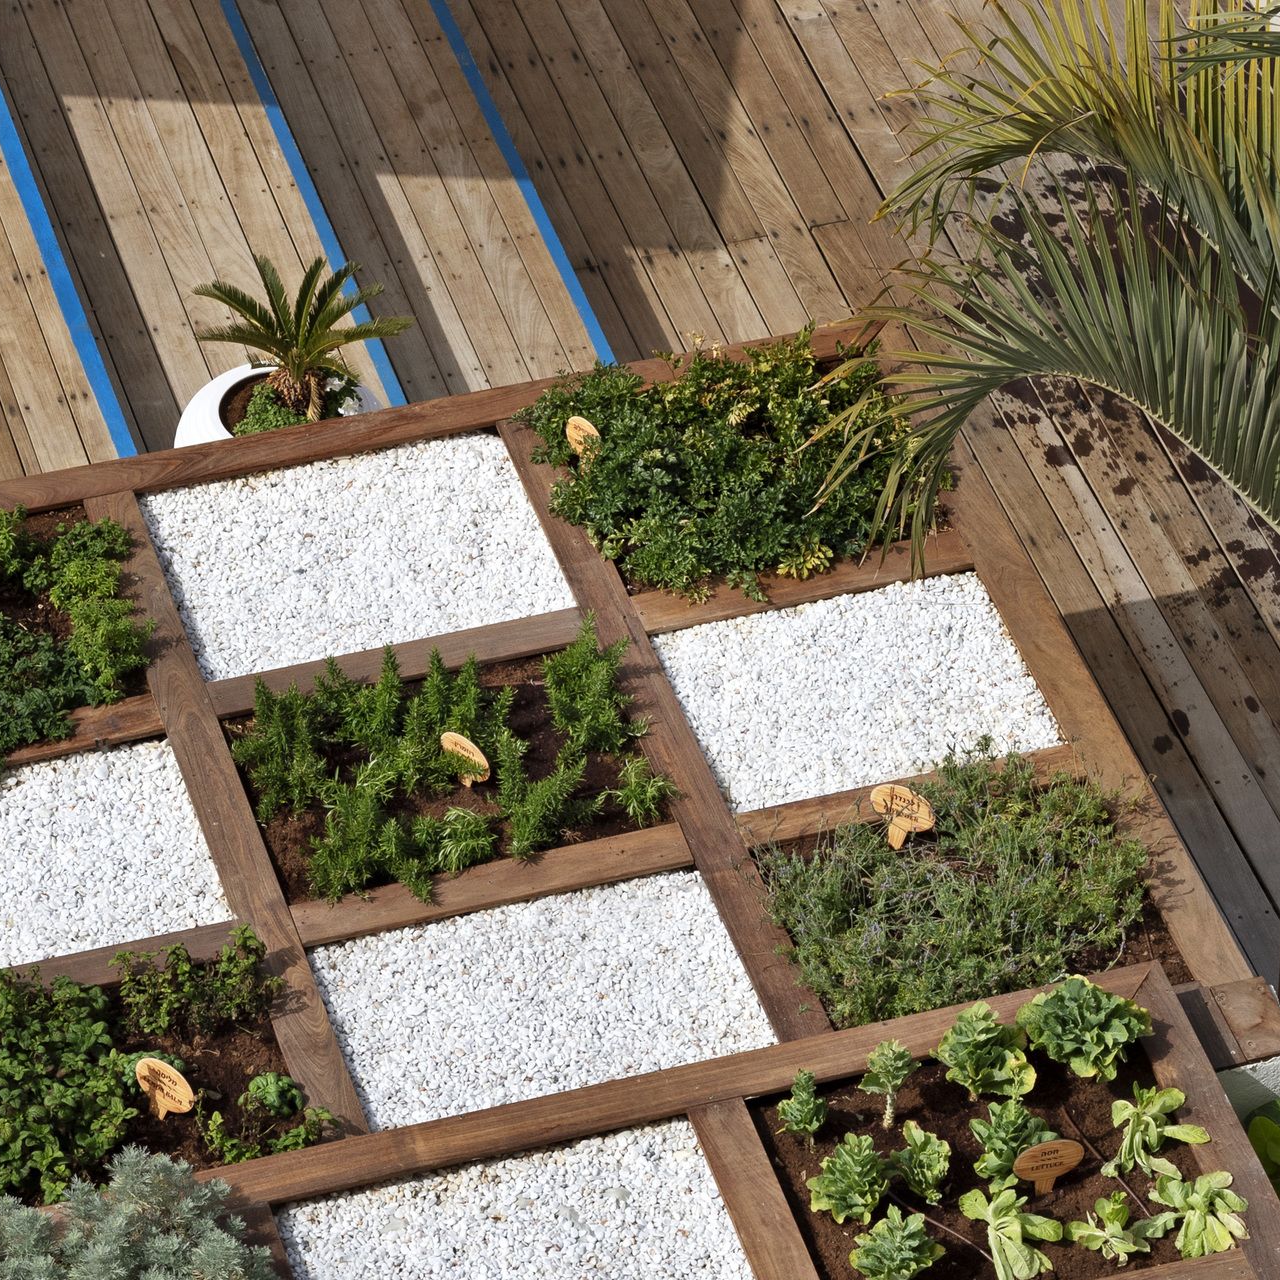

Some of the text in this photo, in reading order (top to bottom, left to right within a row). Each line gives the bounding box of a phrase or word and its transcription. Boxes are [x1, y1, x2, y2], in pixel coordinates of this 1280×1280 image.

[165, 1091, 183, 1105] BALM
[1040, 1149, 1059, 1157] חסה
[1031, 1161, 1065, 1172] LETTUCE
